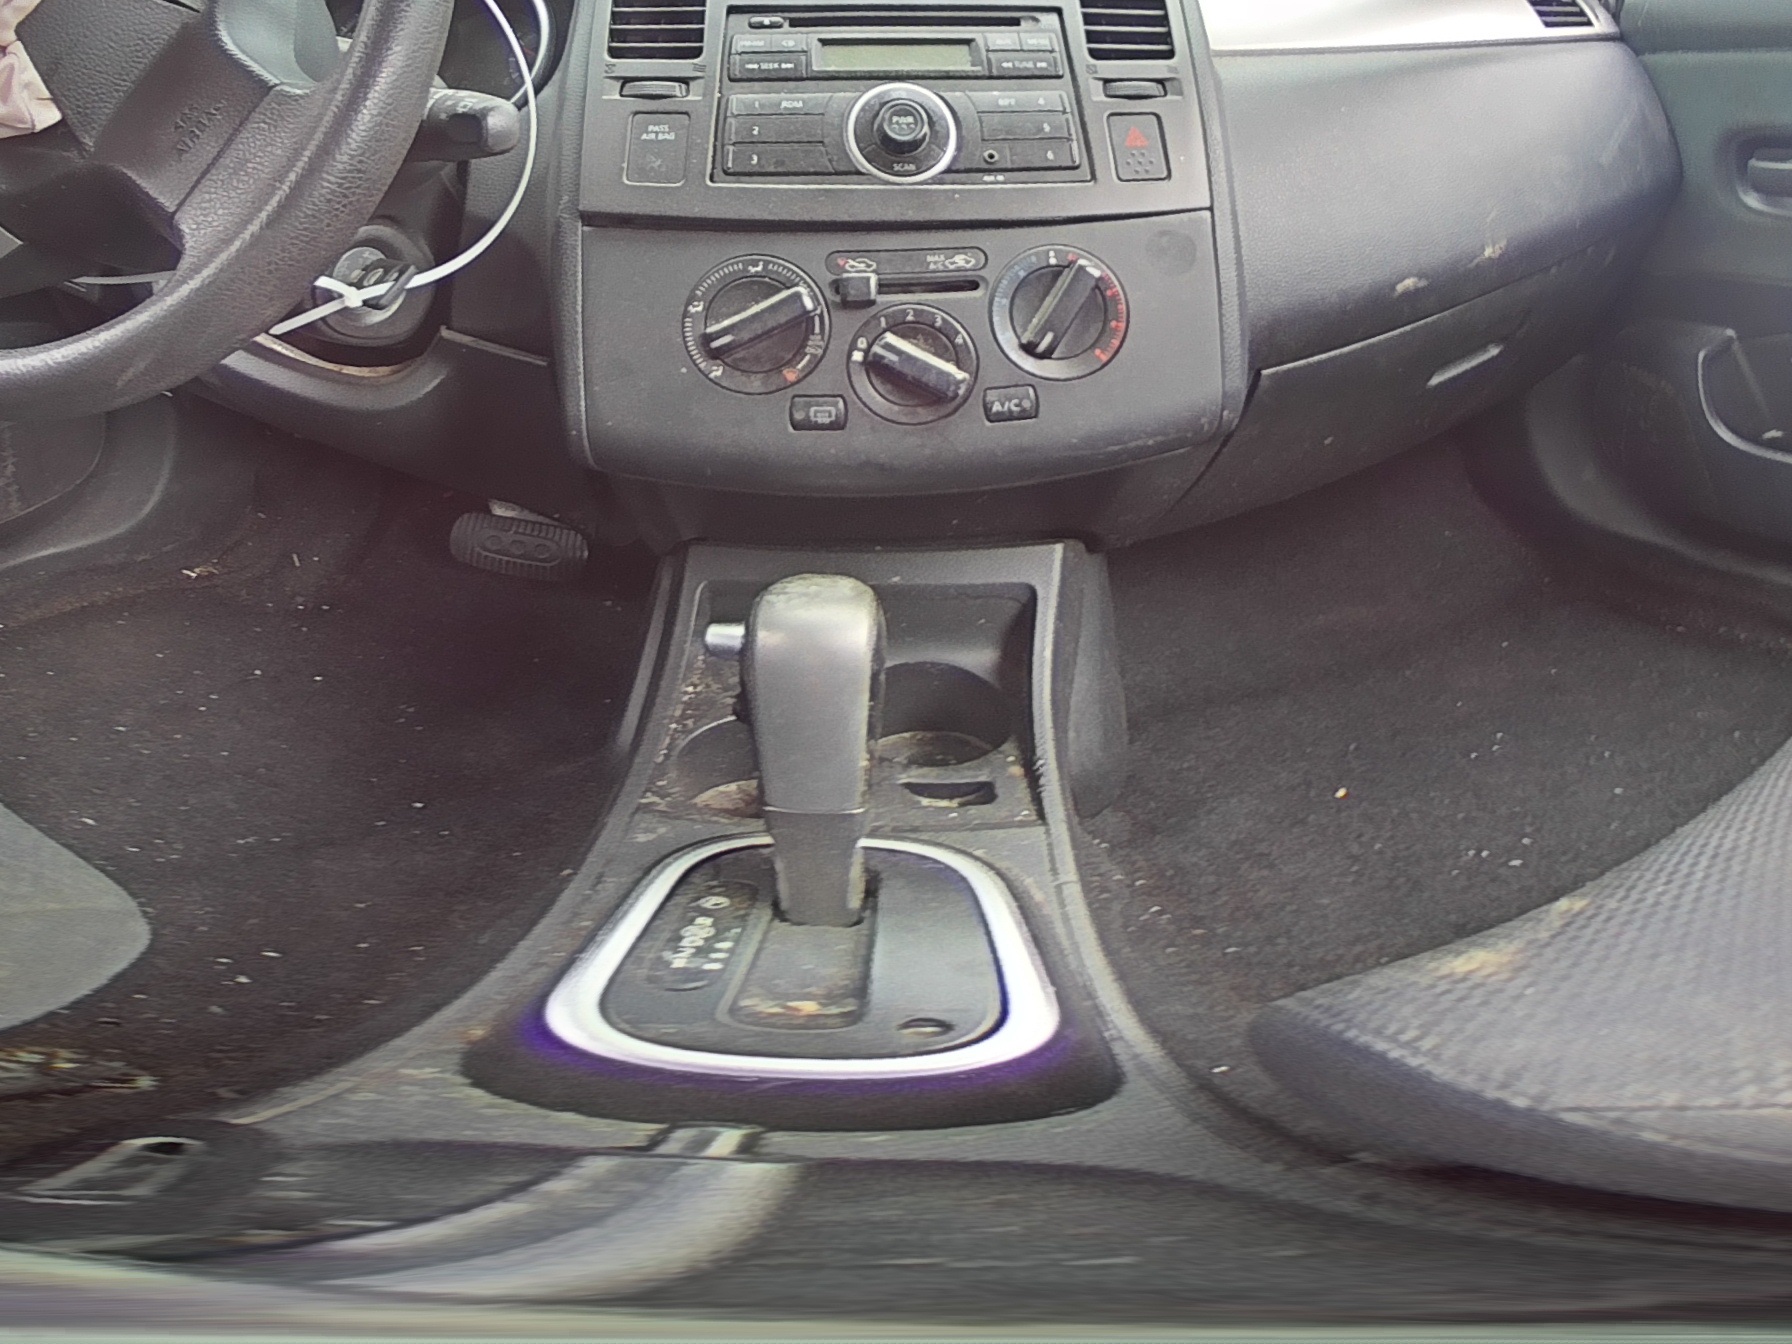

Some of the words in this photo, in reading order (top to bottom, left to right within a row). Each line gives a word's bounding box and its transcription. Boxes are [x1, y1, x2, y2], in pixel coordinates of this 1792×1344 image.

[759, 62, 780, 70] SEEK
[648, 124, 669, 132] PASS
[751, 126, 759, 135] 2
[1042, 122, 1051, 132] 5
[640, 132, 657, 141] AIR
[657, 132, 676, 141] BAG
[750, 155, 758, 165] 3
[1046, 150, 1055, 161] 6
[892, 162, 917, 171] SCAN
[926, 254, 945, 263] MAX
[880, 316, 887, 328] 1
[906, 309, 915, 321] 2
[934, 314, 943, 327] 3
[955, 333, 964, 344] 4
[992, 398, 1021, 412] A/C
